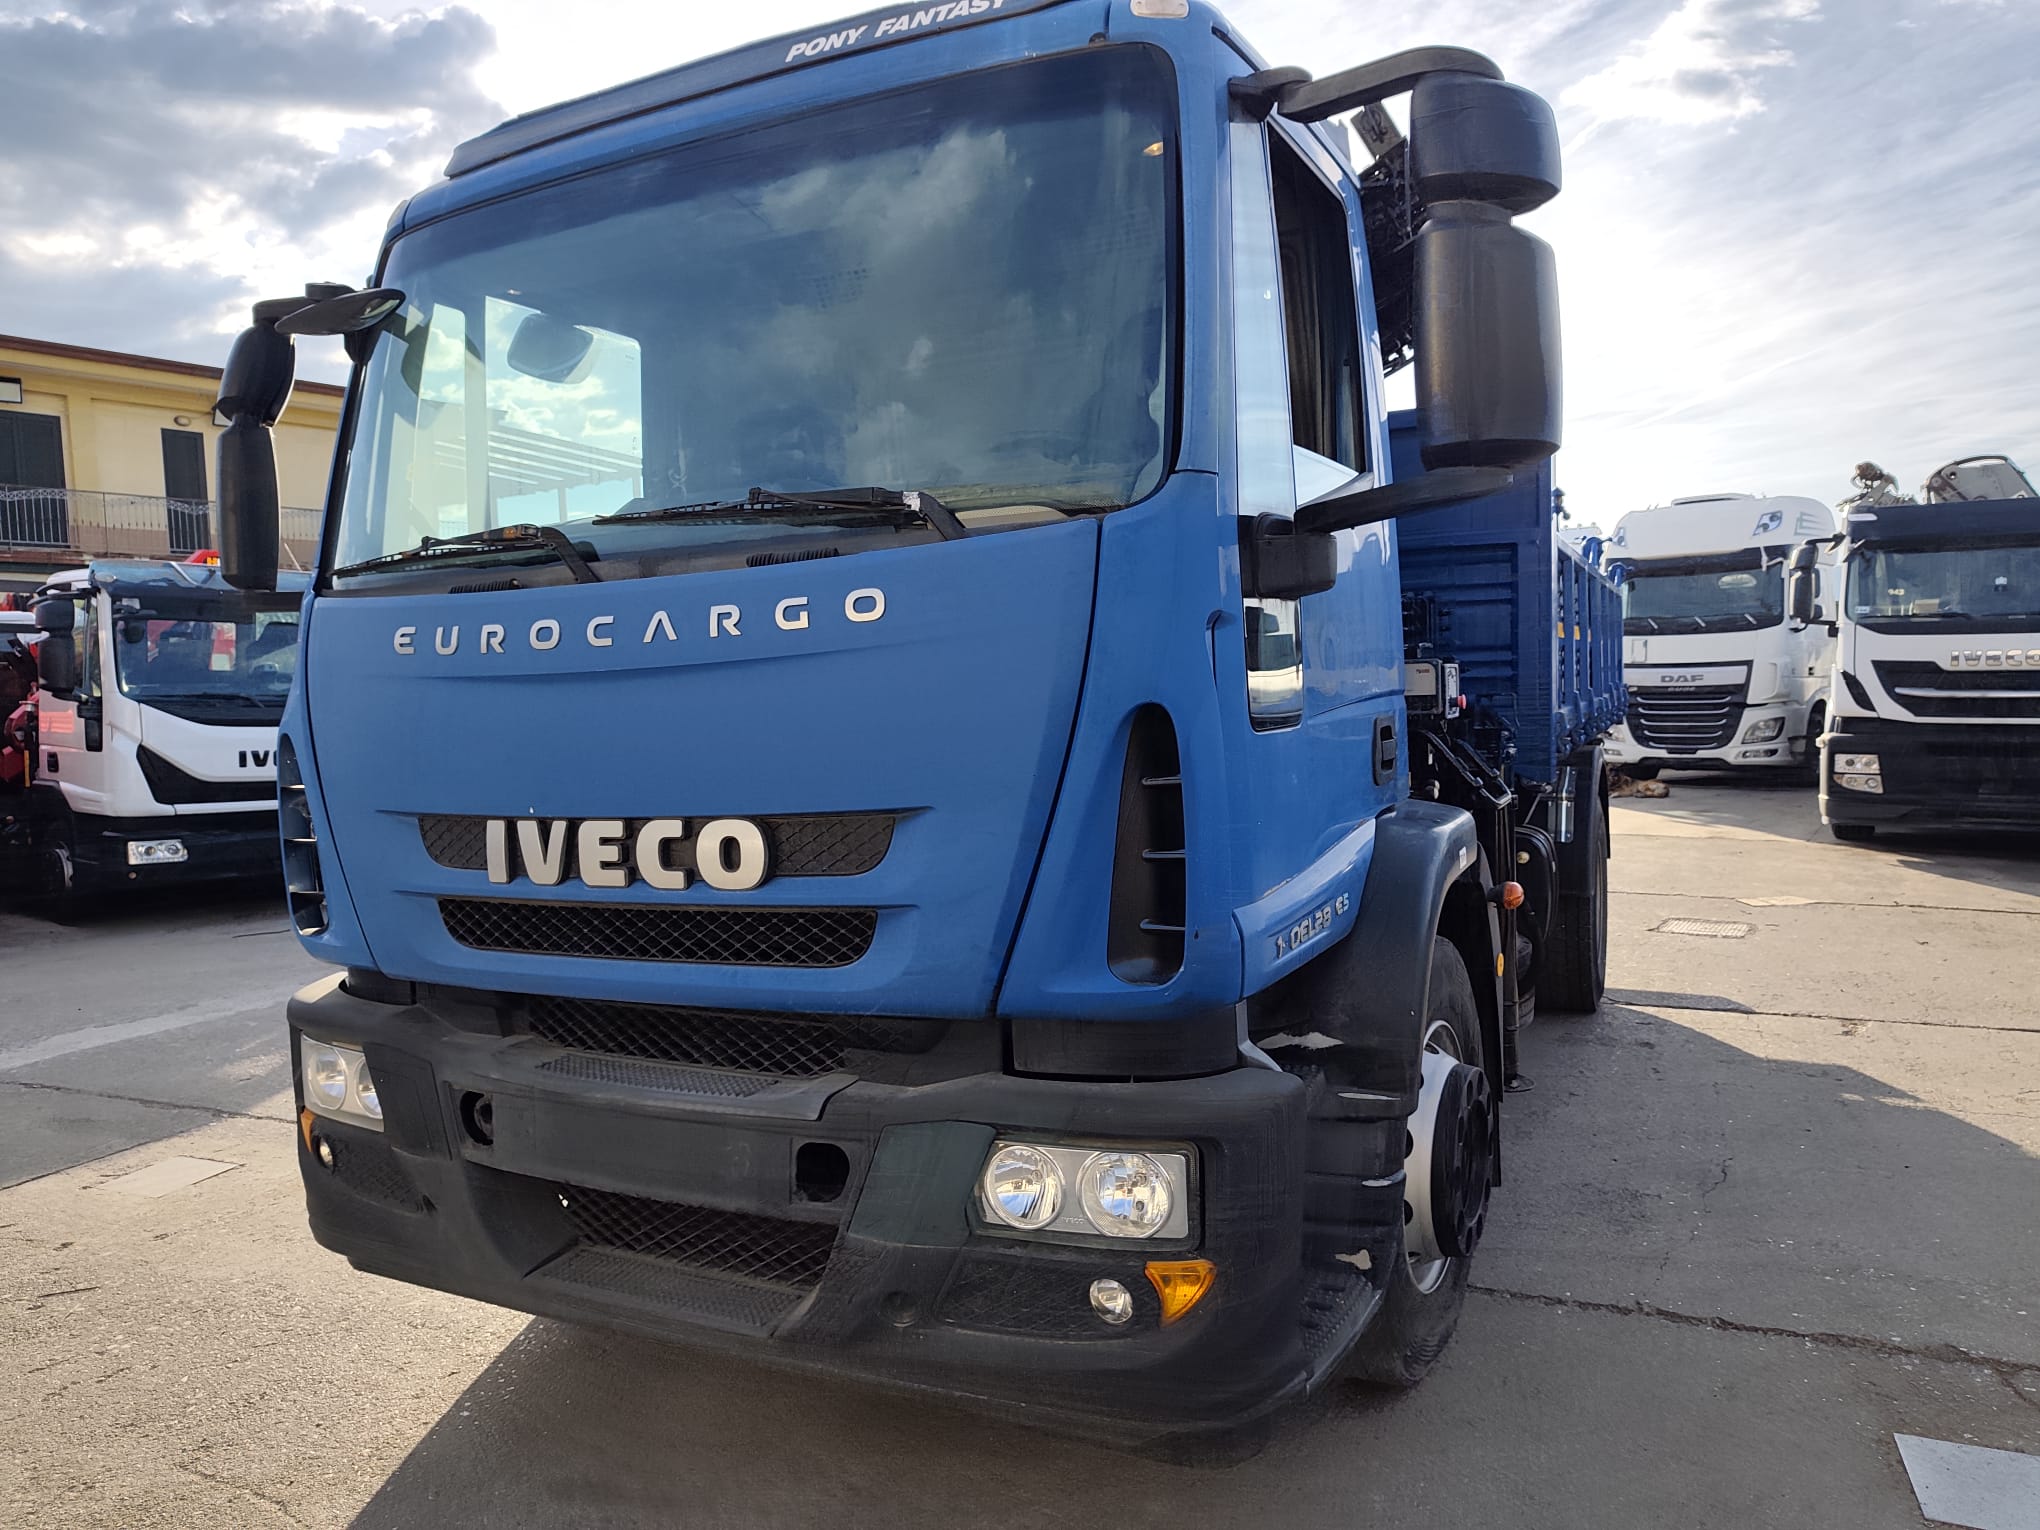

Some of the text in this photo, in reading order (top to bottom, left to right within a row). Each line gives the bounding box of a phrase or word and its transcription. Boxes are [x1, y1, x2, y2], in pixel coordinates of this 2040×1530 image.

[785, 25, 867, 62] PONY
[393, 587, 886, 656] EUROCARGO
[1951, 649, 2040, 667] IVECO
[1660, 674, 1704, 683] DAF
[486, 818, 772, 891] IVECO
